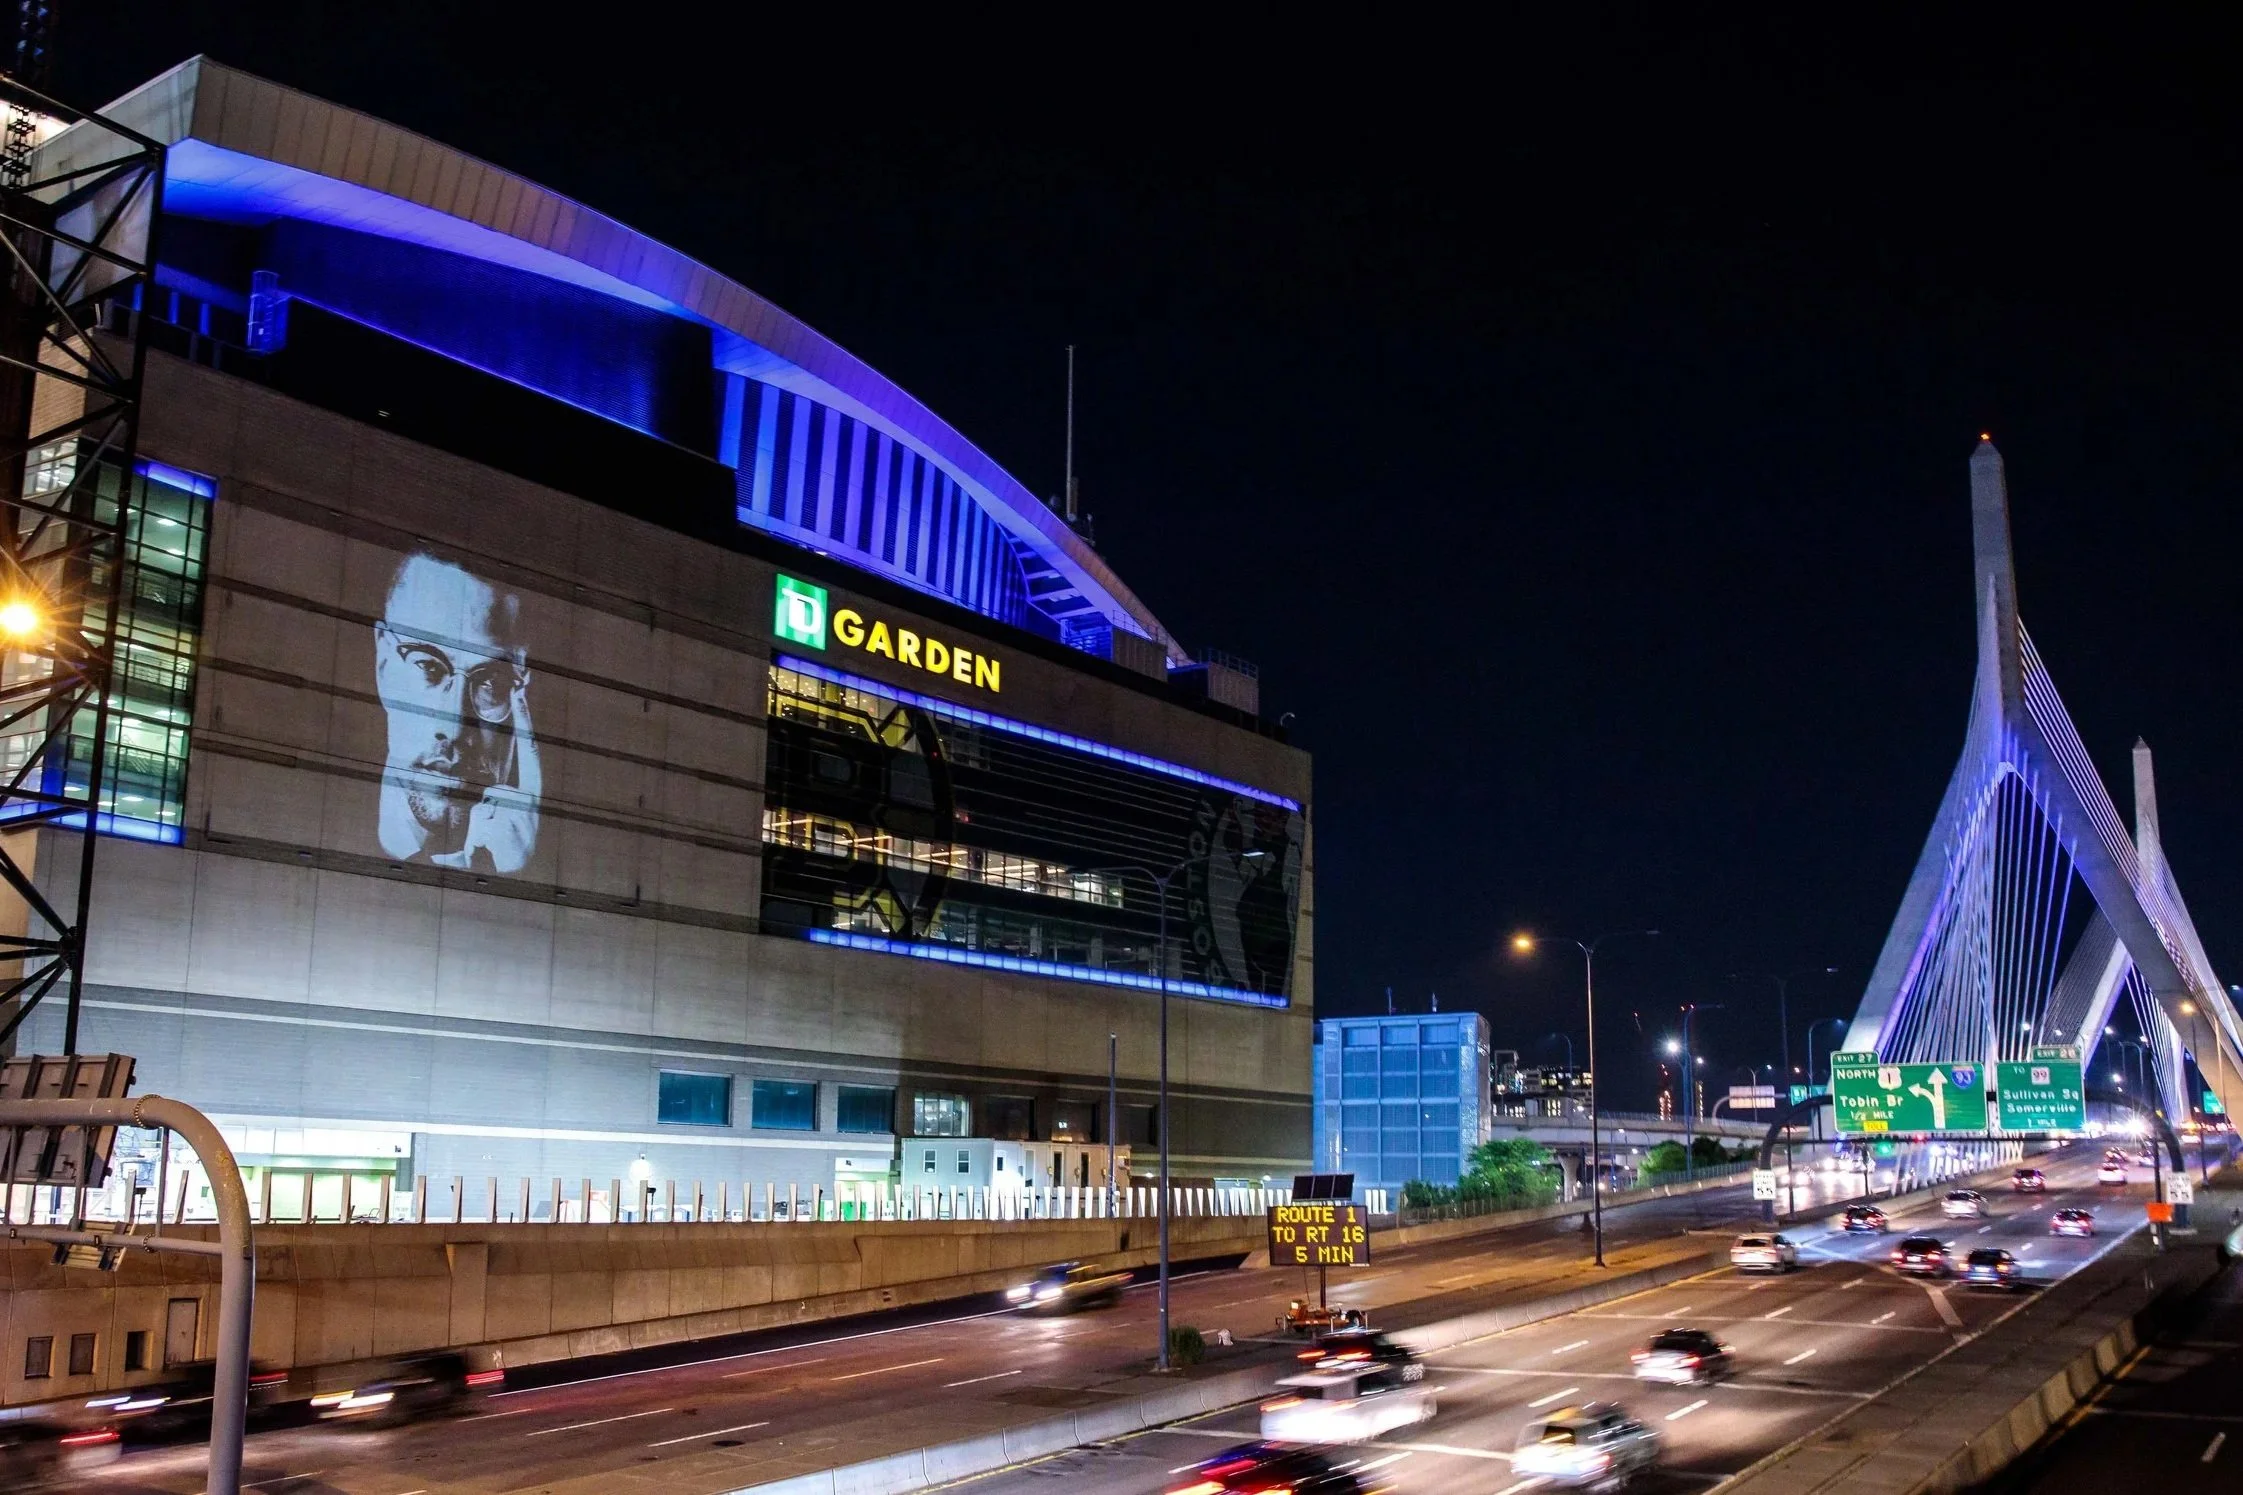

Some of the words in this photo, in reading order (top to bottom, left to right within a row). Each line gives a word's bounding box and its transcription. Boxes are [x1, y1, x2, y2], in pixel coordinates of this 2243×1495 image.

[782, 588, 822, 635] TD
[833, 609, 1000, 693] GARDEN
[1858, 1053, 1873, 1063] 27
[2037, 1050, 2055, 1058] EXIT
[1836, 1069, 1876, 1079] NORTH
[1887, 1072, 1892, 1085] 1
[1955, 1071, 1971, 1085] 93
[2013, 1066, 2025, 1074] TO
[2033, 1069, 2048, 1080] 99
[1839, 1095, 1879, 1108] Tobin
[1886, 1094, 1904, 1107] Br
[2003, 1089, 2055, 1100] Sullivan
[2062, 1088, 2079, 1101] Sq
[1873, 1110, 1894, 1119] MILE
[2007, 1102, 2076, 1113] Somerville
[1277, 1206, 1335, 1223] ROUTE
[1347, 1206, 1356, 1223] 1
[1272, 1226, 1296, 1243] TO
[1306, 1226, 1330, 1243] RT
[1342, 1225, 1365, 1243] 16
[1295, 1246, 1308, 1263] 5
[1318, 1246, 1354, 1263] MIN
